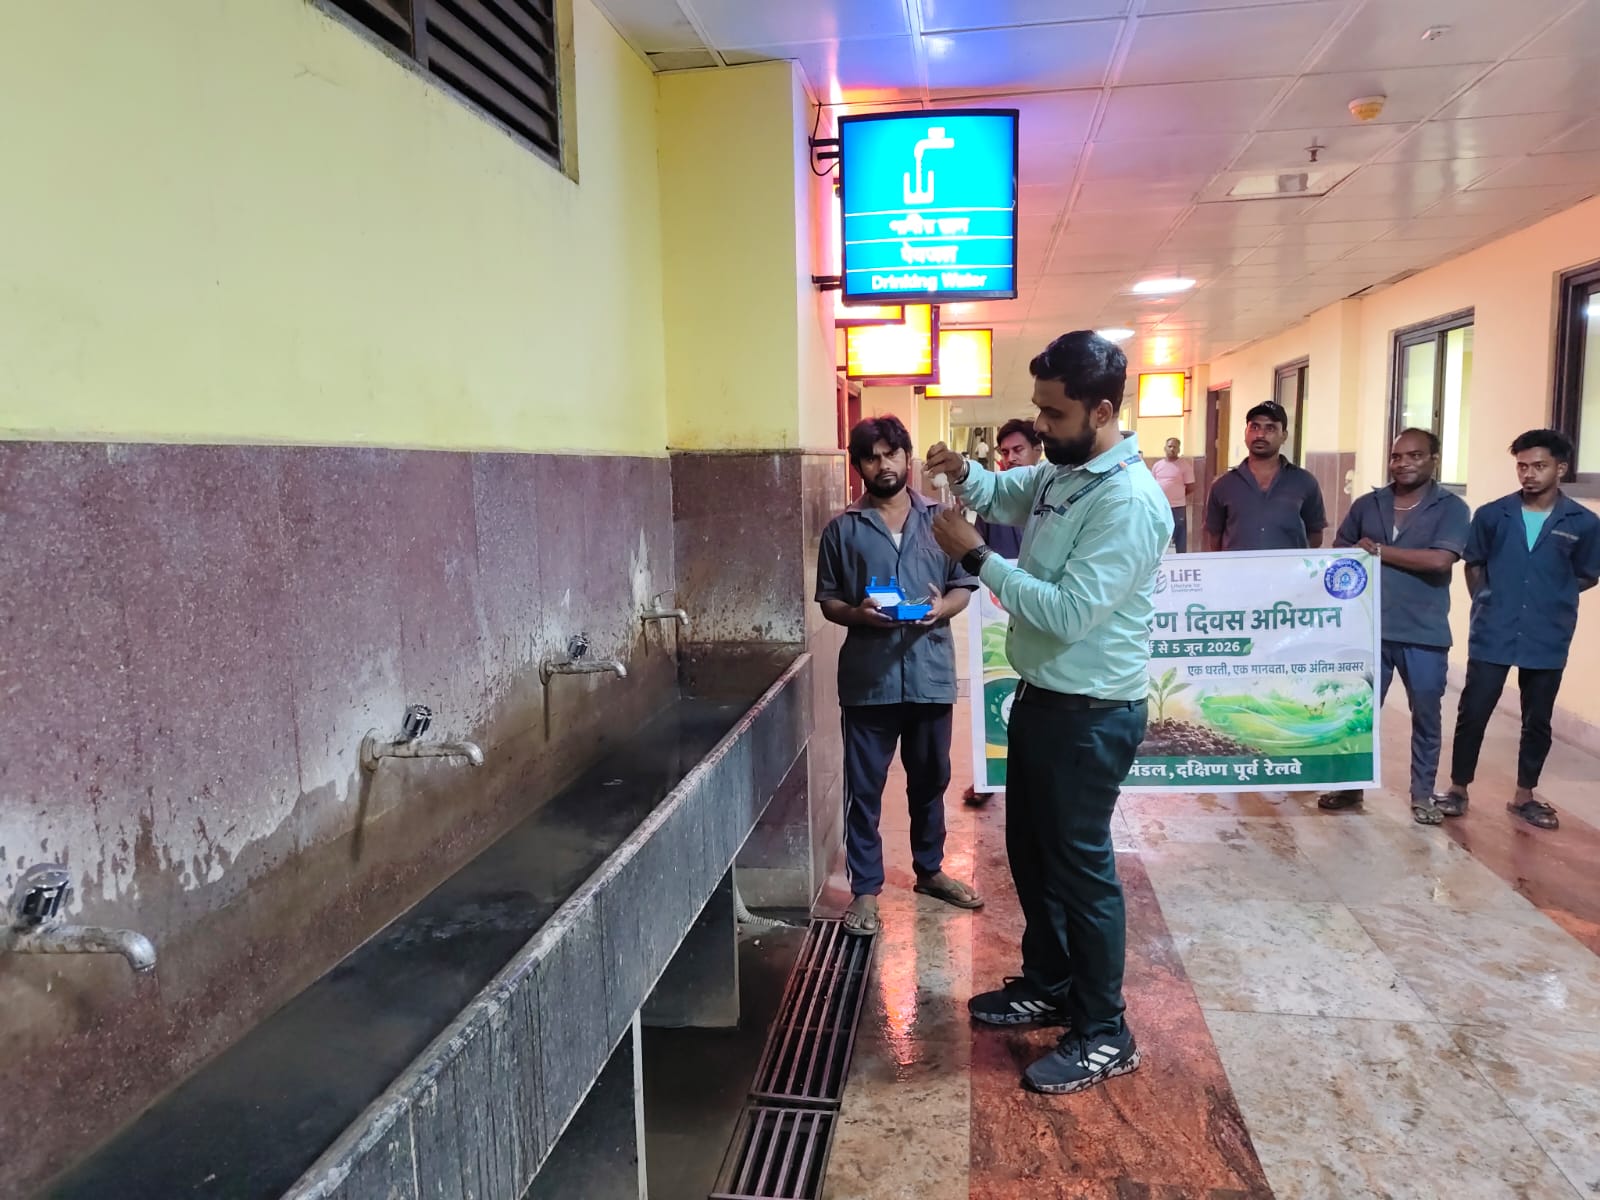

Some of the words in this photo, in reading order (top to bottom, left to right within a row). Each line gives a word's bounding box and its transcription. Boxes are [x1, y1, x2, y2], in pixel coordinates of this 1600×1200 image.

[871, 274, 938, 292] Drinking
[941, 272, 988, 288] Water
[1170, 569, 1202, 582] LiFE
[1185, 603, 1246, 634] दिवस
[1250, 601, 1343, 631] अभियान
[1157, 640, 1169, 654] से
[1172, 643, 1180, 653] 5
[1183, 642, 1203, 656] जून
[1207, 641, 1240, 653] 2026
[1187, 665, 1203, 676] एक
[1205, 662, 1231, 676] धरती,
[1232, 664, 1249, 675] एक
[1251, 663, 1289, 675] मानवता,
[1290, 663, 1307, 674] एक
[1309, 660, 1335, 673] अंतिम
[1337, 661, 1364, 672] अवसर
[1176, 759, 1228, 778] दक्षिण
[1233, 758, 1259, 781] पूर्व
[1264, 758, 1302, 777] रेलवे
